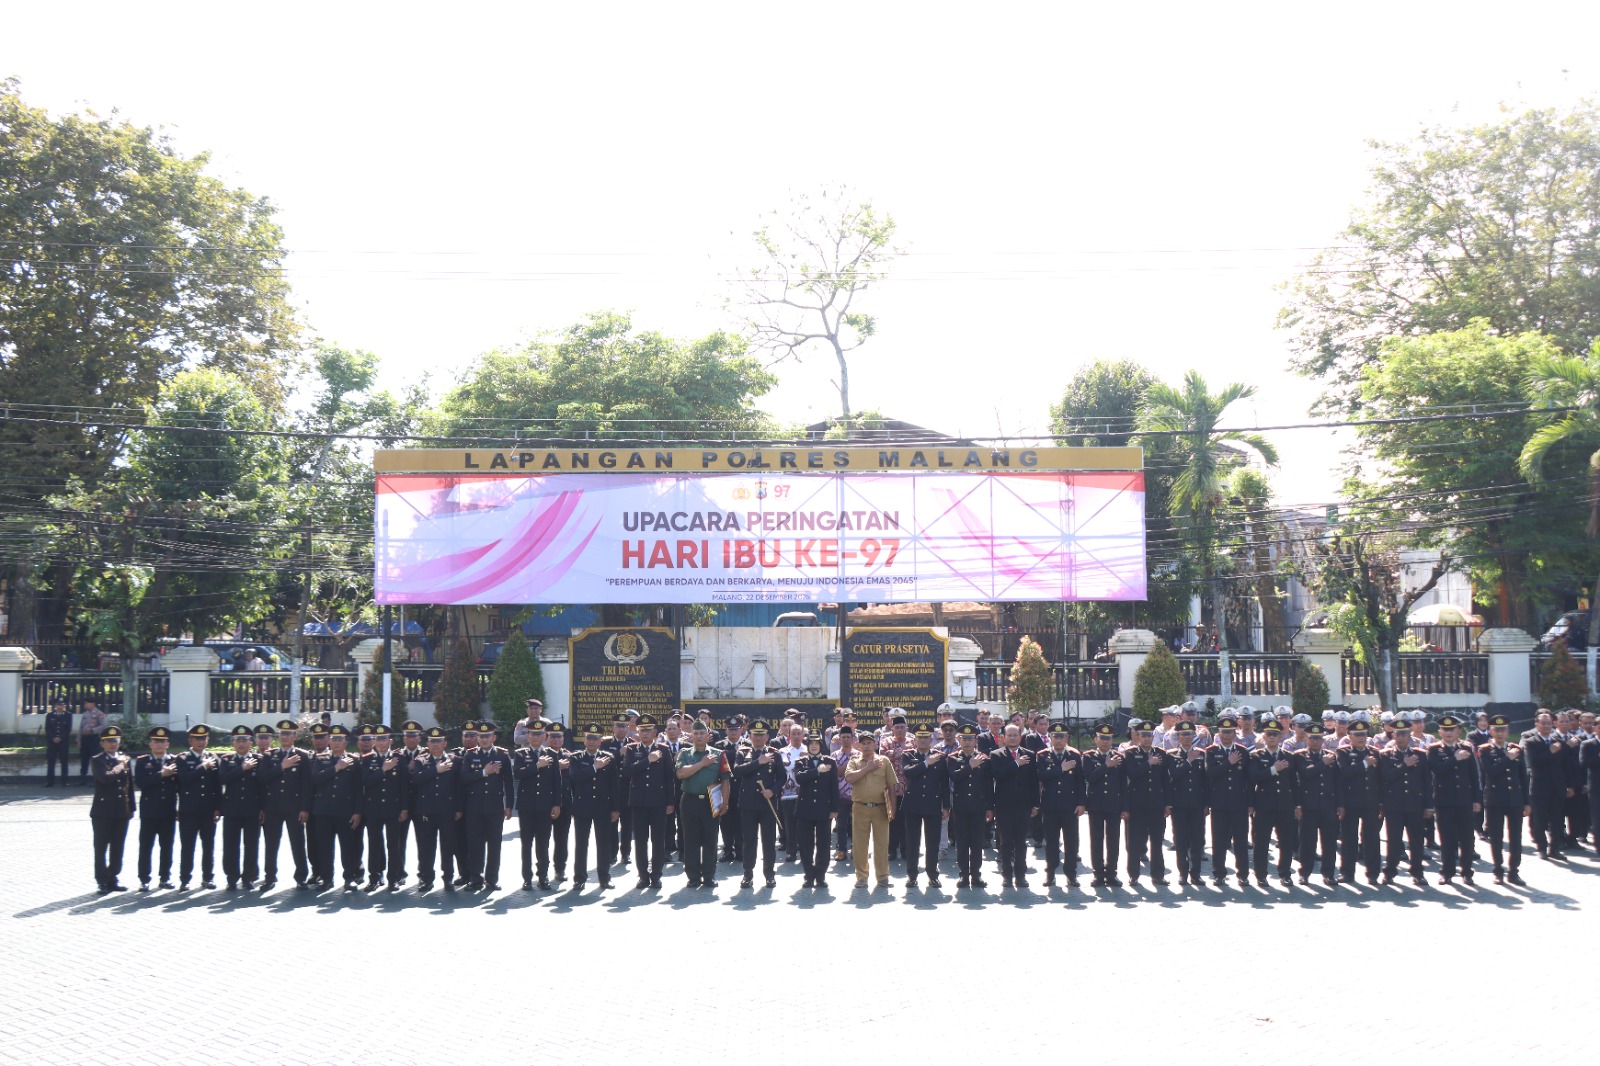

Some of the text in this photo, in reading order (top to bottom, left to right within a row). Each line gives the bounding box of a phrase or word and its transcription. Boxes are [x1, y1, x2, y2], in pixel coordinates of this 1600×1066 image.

[464, 450, 1039, 469] LAPANGAN POLRES MALANG
[774, 485, 791, 498] 97
[623, 511, 899, 532] UPACARA PERINGATAN
[622, 538, 900, 568] HARI IBU KE-97
[664, 577, 704, 586] BERDAYA
[706, 577, 726, 586] DAN
[727, 577, 775, 587] BERKARYA,
[777, 577, 814, 586] MENUJU
[815, 577, 864, 586] INDONESIA
[866, 576, 891, 585] EMAS
[853, 644, 930, 655] CATUR PRASETYA
[602, 665, 646, 676] TRI BRATA
